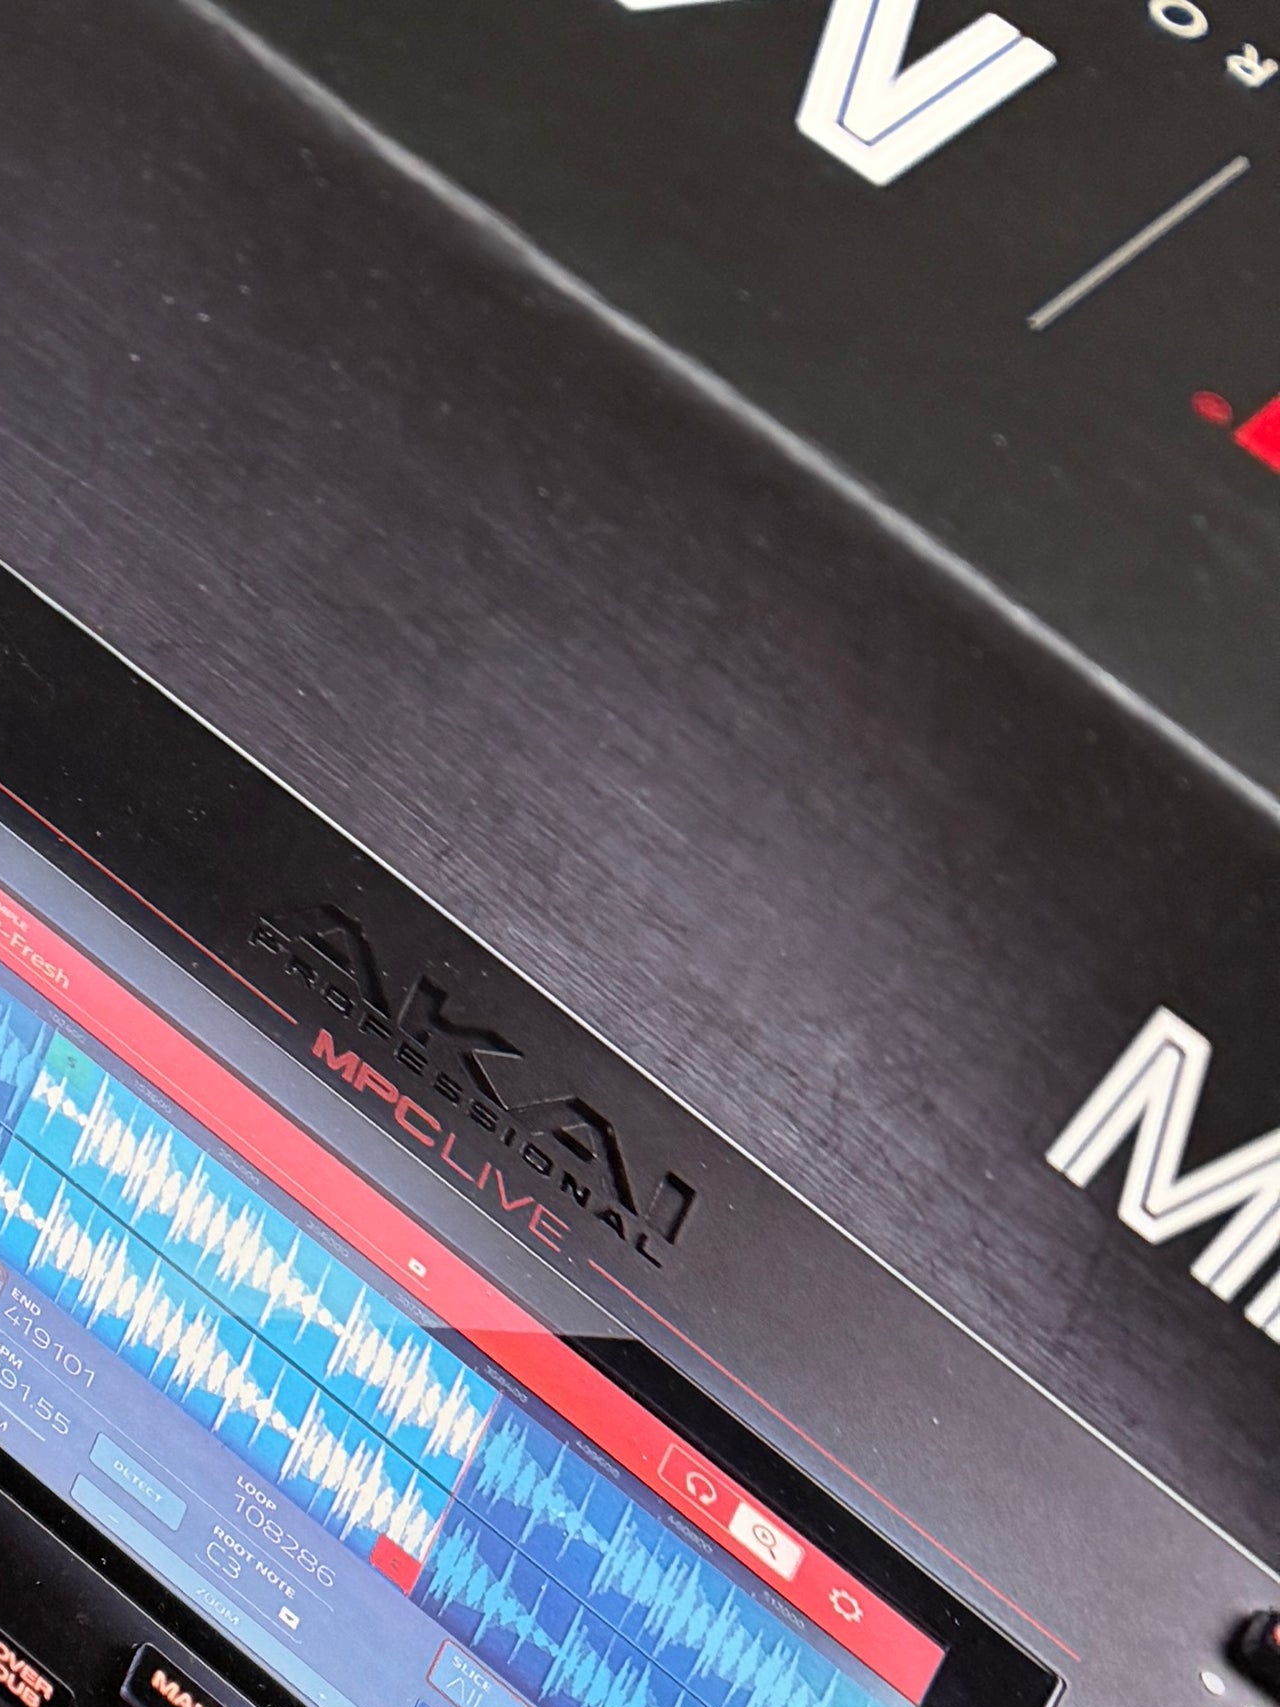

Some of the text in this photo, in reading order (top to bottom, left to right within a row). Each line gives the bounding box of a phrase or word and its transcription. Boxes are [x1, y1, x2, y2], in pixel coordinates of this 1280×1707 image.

[248, 926, 664, 1268] PROFESSIONAL
[257, 903, 697, 1245] AKAI
[11, 1288, 42, 1316] END
[3, 1306, 96, 1388] 419101
[235, 1475, 278, 1512] LOOP
[206, 1542, 242, 1580] C3
[213, 1525, 297, 1600] ROOT NOTE
[234, 1494, 335, 1588] 108286
